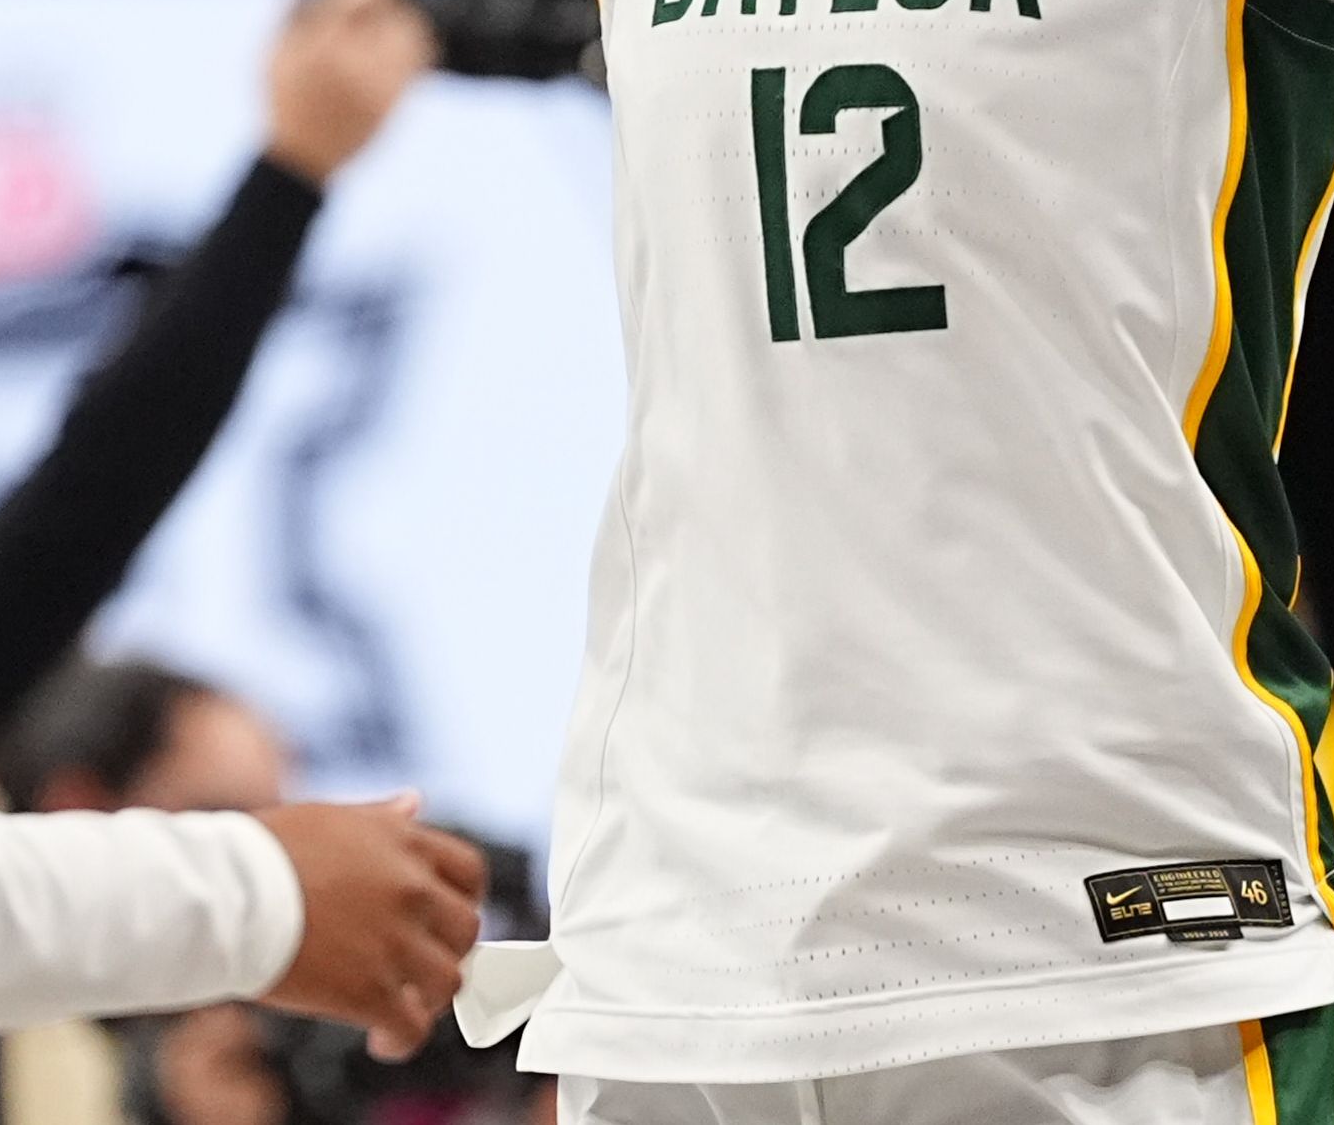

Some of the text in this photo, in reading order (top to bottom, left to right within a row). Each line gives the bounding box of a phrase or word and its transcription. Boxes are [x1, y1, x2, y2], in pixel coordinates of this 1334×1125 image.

[751, 63, 947, 343] 12
[1241, 880, 1267, 905] 46
[1110, 902, 1153, 920] ELITE
